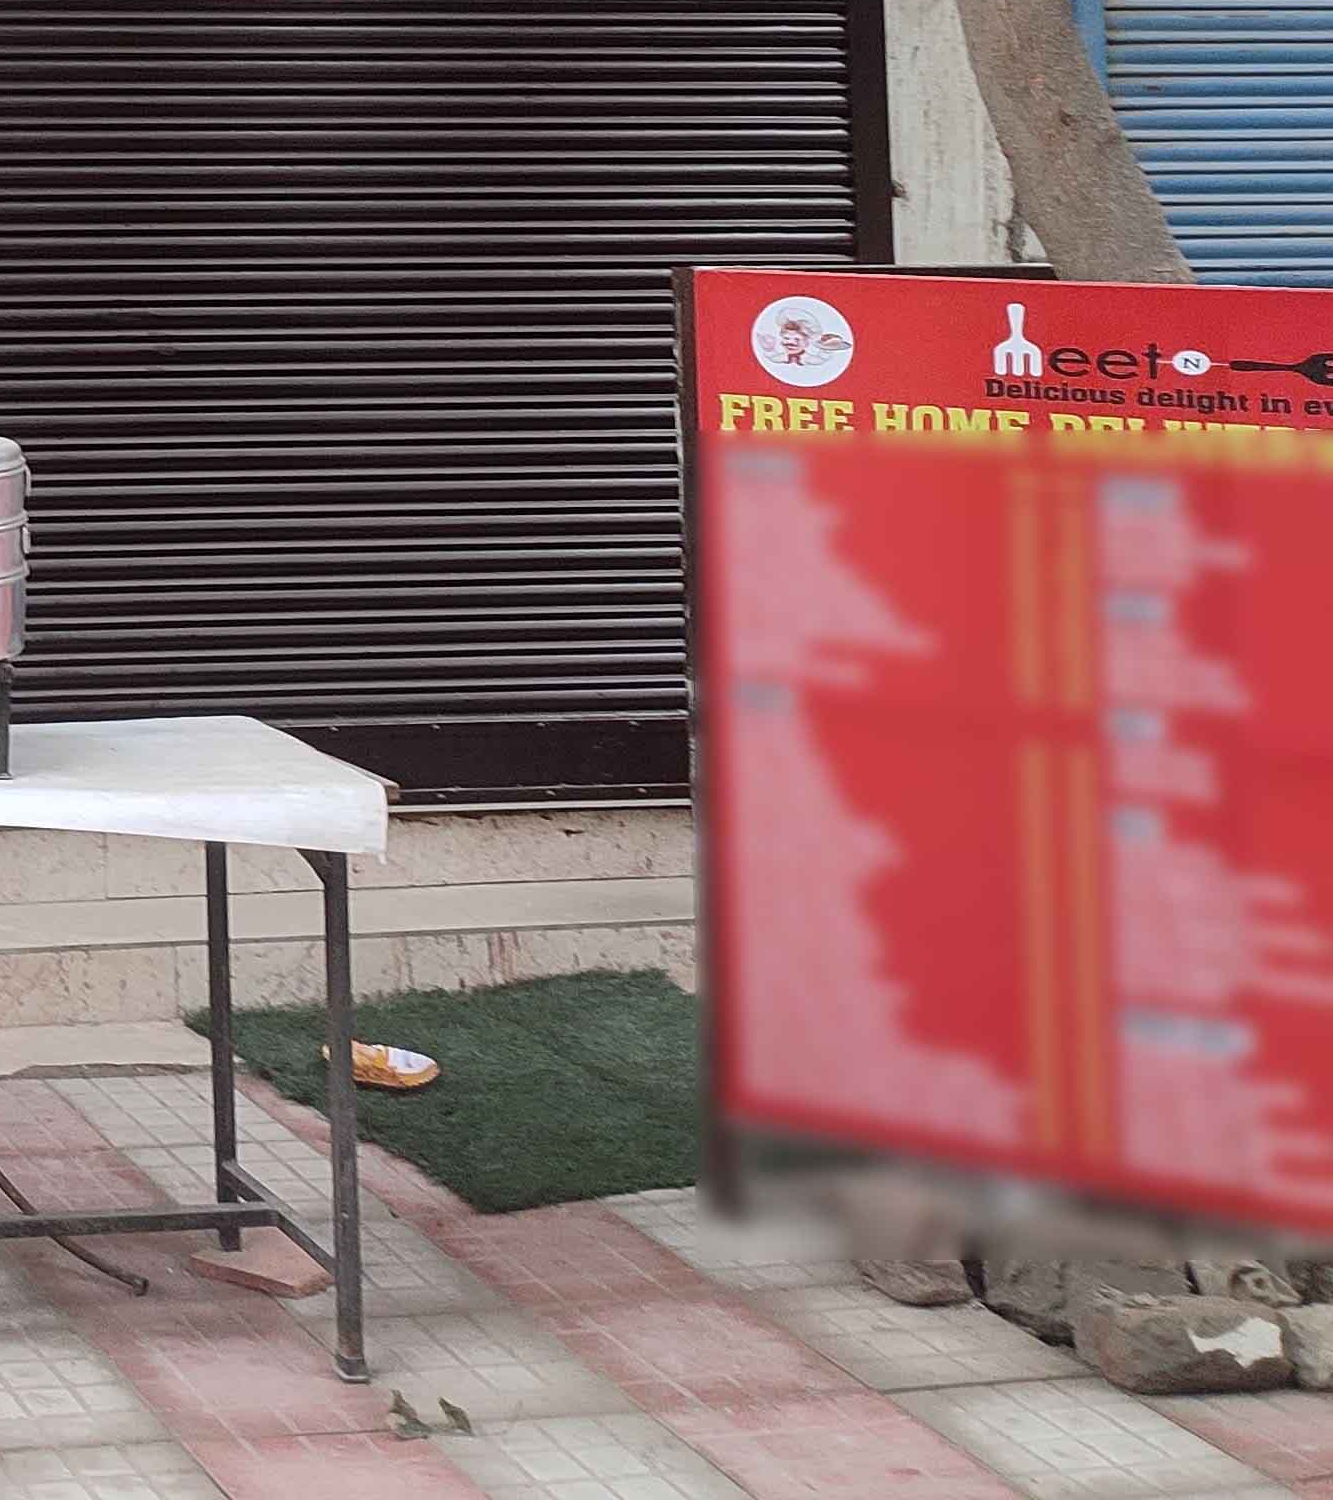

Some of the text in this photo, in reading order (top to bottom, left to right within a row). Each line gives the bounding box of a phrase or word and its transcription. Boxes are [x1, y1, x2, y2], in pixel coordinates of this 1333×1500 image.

[718, 393, 855, 432] FREE
[984, 378, 1126, 404] Delicious
[1137, 388, 1248, 415] delight
[1261, 393, 1291, 414] in
